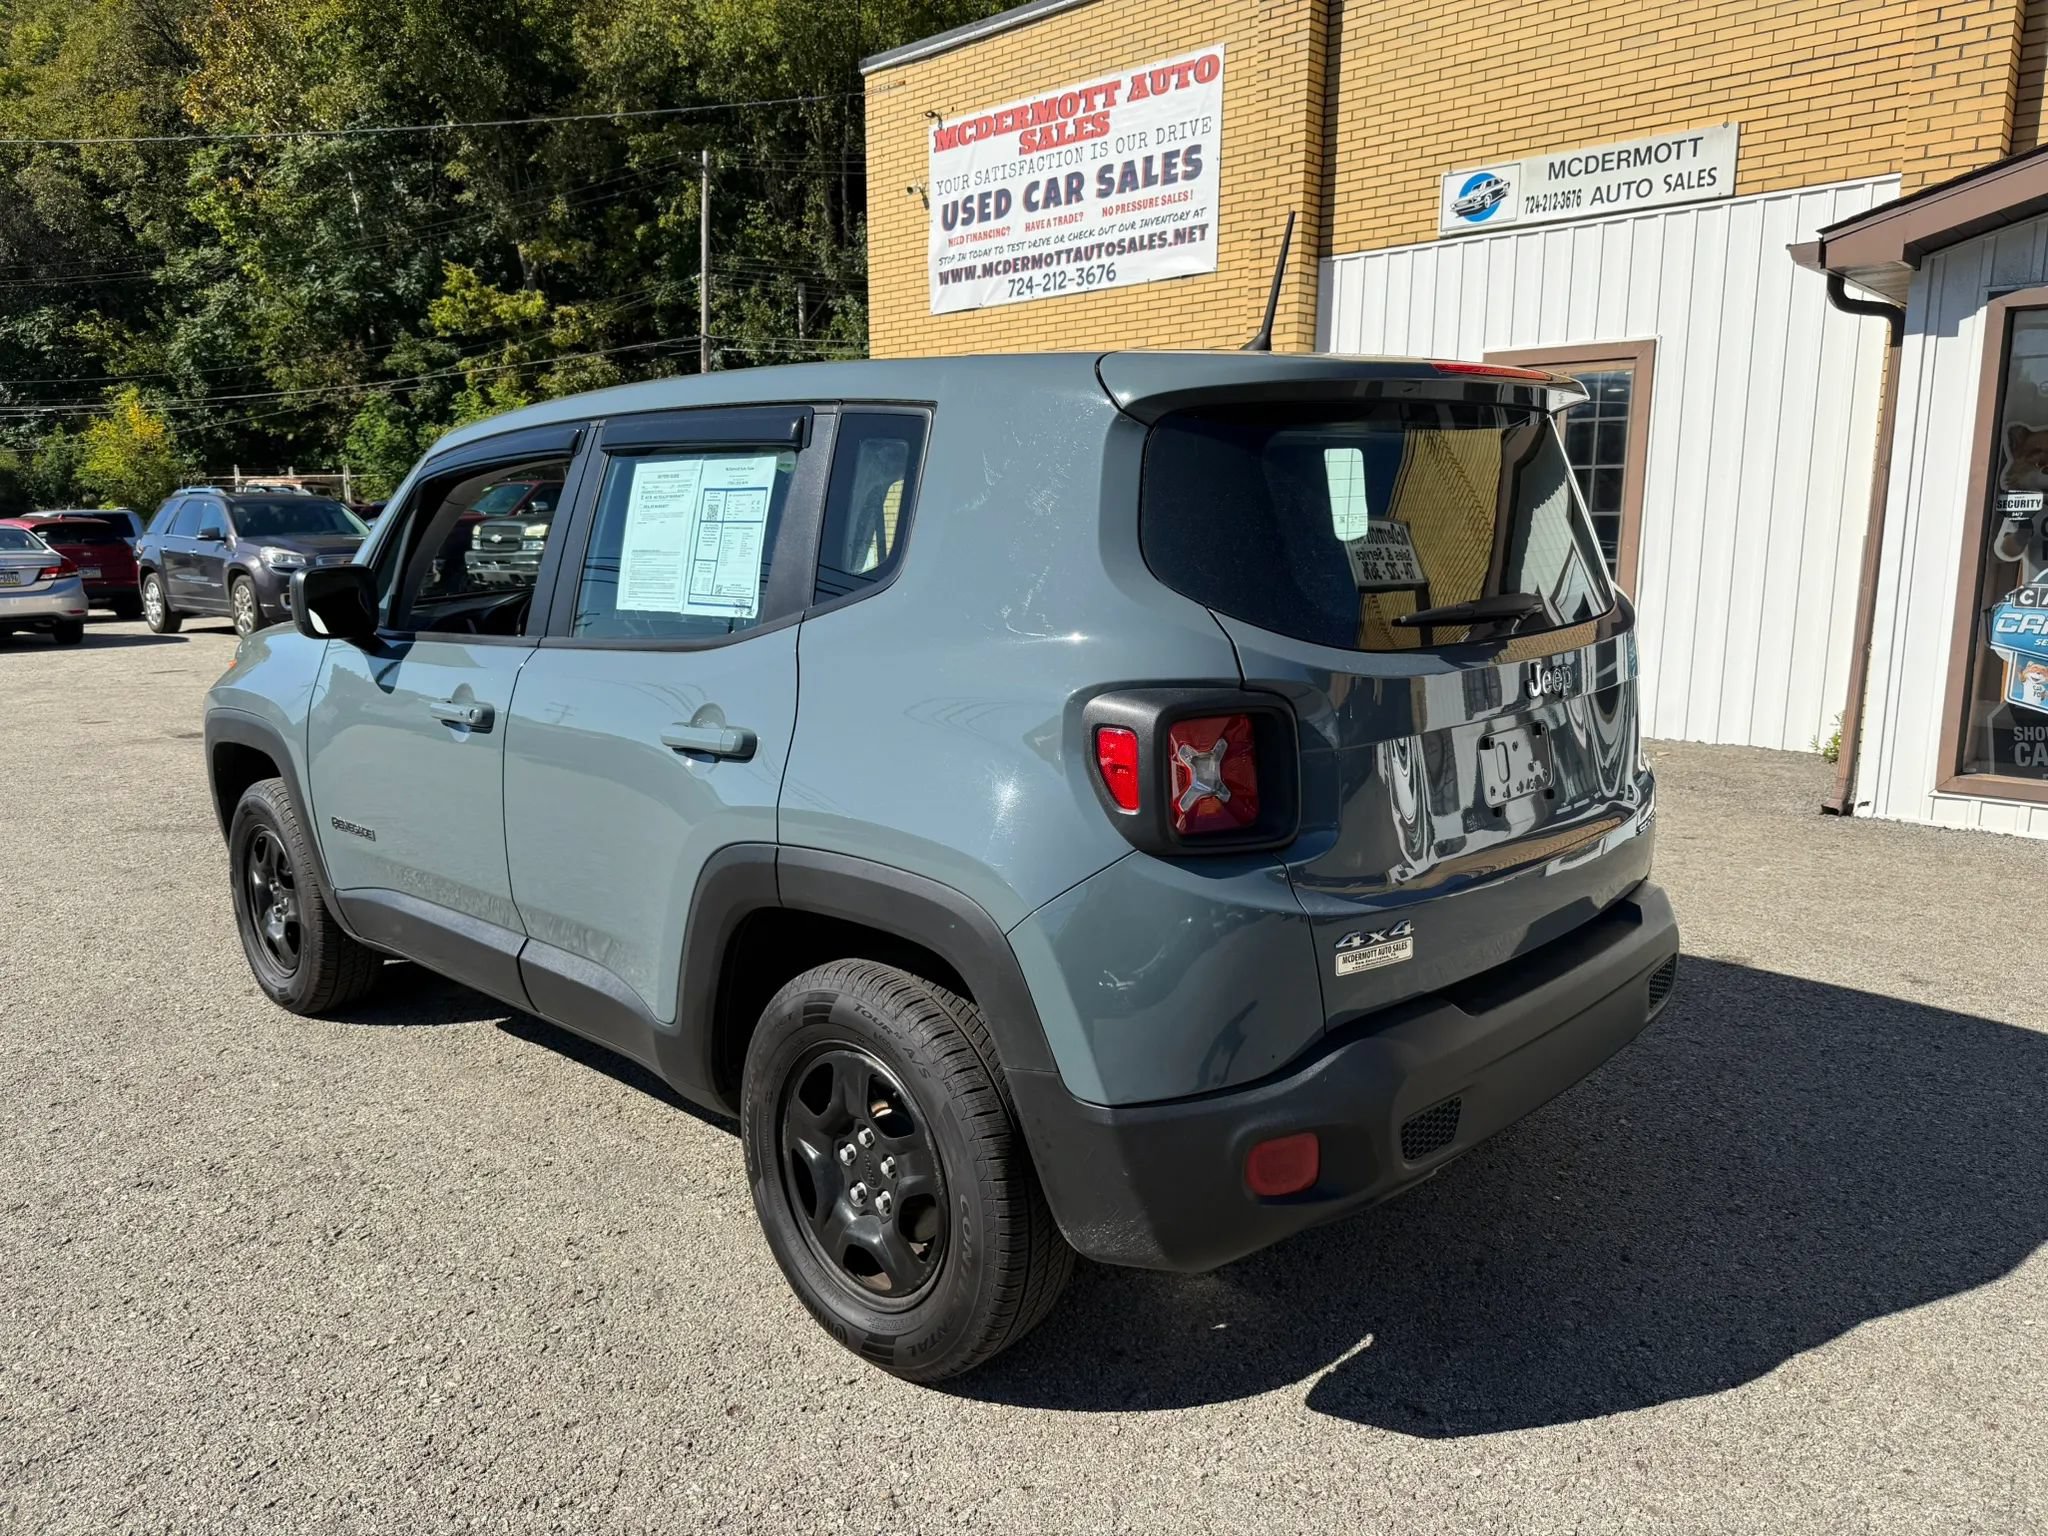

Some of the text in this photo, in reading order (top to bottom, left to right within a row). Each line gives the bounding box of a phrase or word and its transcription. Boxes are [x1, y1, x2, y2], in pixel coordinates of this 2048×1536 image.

[934, 54, 1220, 153] MCDERMOTT AUTO
[936, 116, 1212, 196] YOUR SATISFACTION IS OUR DRIVE
[1019, 111, 1110, 156] SALES
[1548, 136, 1704, 181] MCDERMOTT
[941, 144, 1203, 231] USED CAR SALES
[1102, 205, 1113, 217] NO
[1115, 196, 1159, 215] PRESSURE
[1525, 166, 1717, 215] 724-212-3676 AUTO SALES
[939, 207, 1207, 266] STOP IN TODAY TO TEST DRIVE OR CHECK OUT OUR INVENTORY AT
[966, 226, 1011, 244] FINANCING?
[1025, 211, 1084, 232] HAVE A TRADE?
[938, 223, 1209, 286] WWW.MCDERMOTTAUTOSALES.NET
[1008, 262, 1117, 298] 724-212-3676
[1996, 499, 2041, 509] SECURITY
[1527, 662, 1572, 697] Jeep
[1342, 949, 1377, 964] MCDERMOTT
[1378, 946, 1392, 957] AUTO
[1392, 942, 1408, 953] SALES
